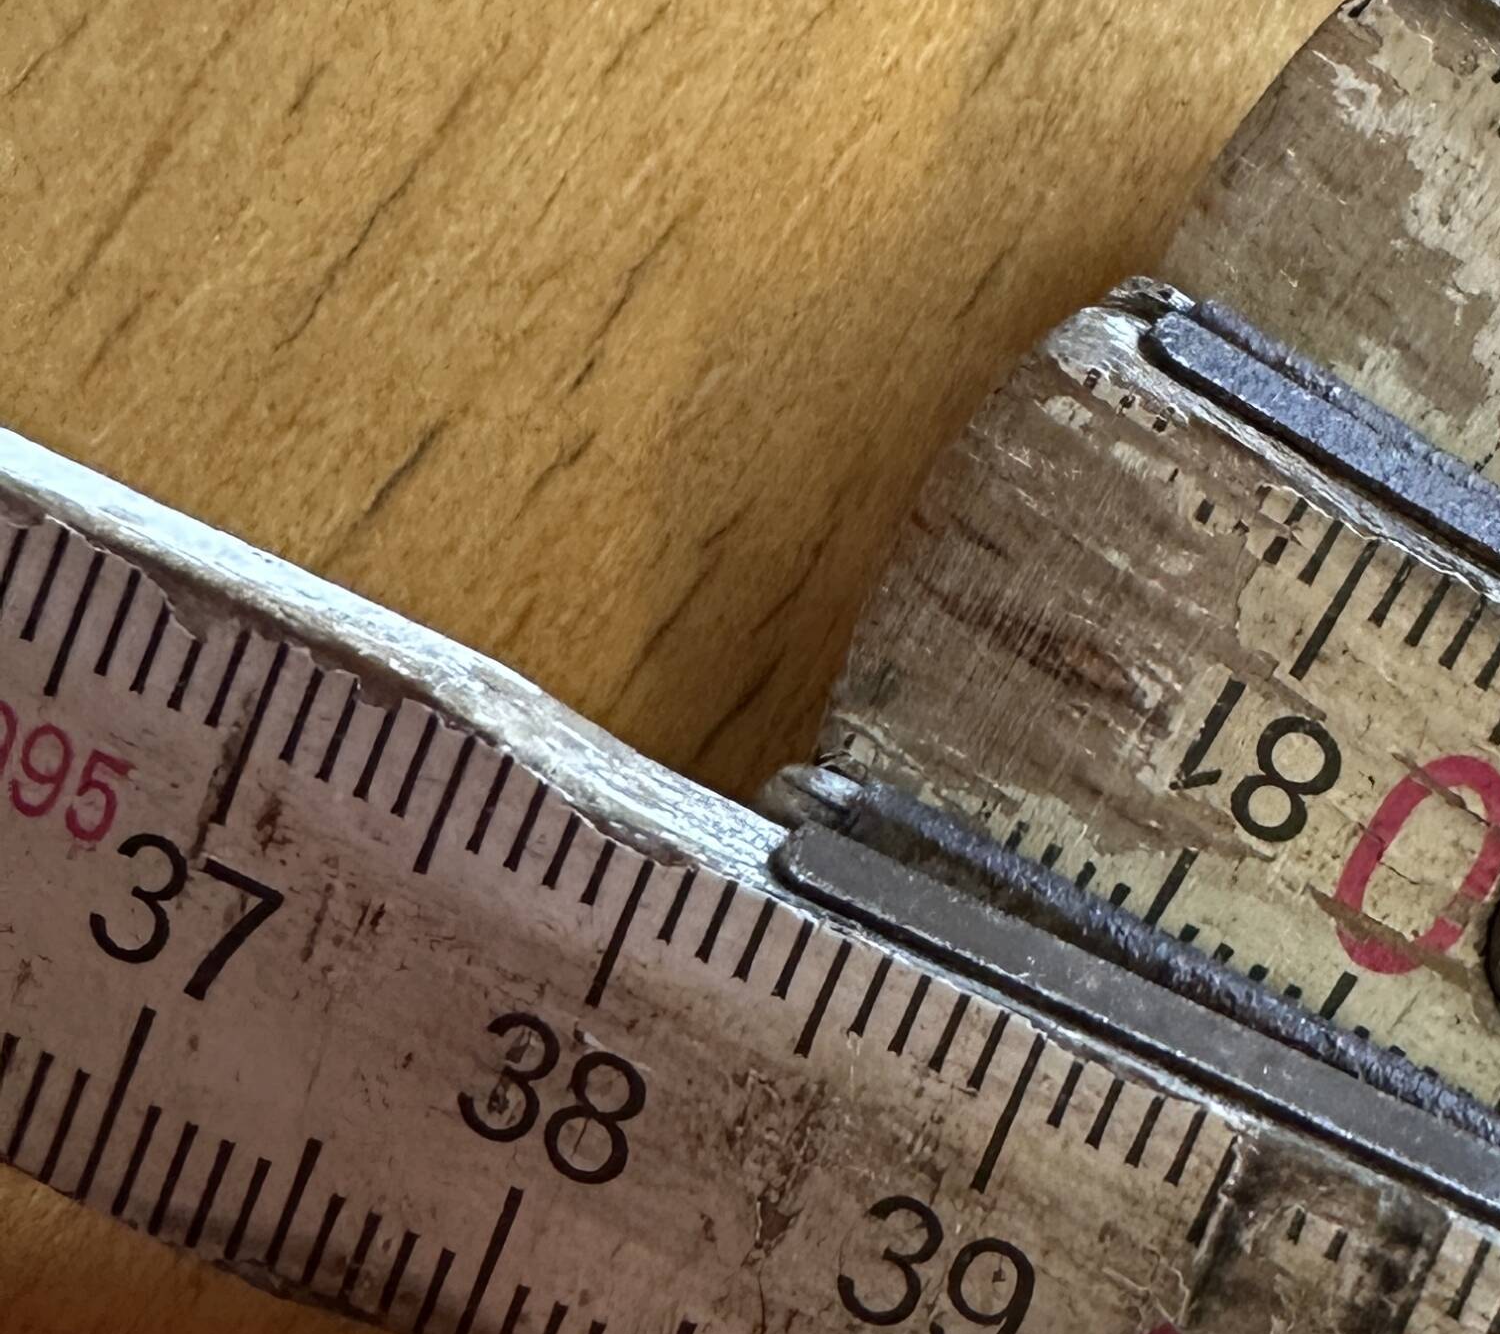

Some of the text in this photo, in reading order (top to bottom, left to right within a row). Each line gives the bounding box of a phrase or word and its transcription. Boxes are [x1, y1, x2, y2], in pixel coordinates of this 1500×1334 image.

[0, 699, 137, 843] 95
[1169, 677, 1342, 842] 81
[88, 832, 286, 1002] 37
[456, 1012, 648, 1185] 38
